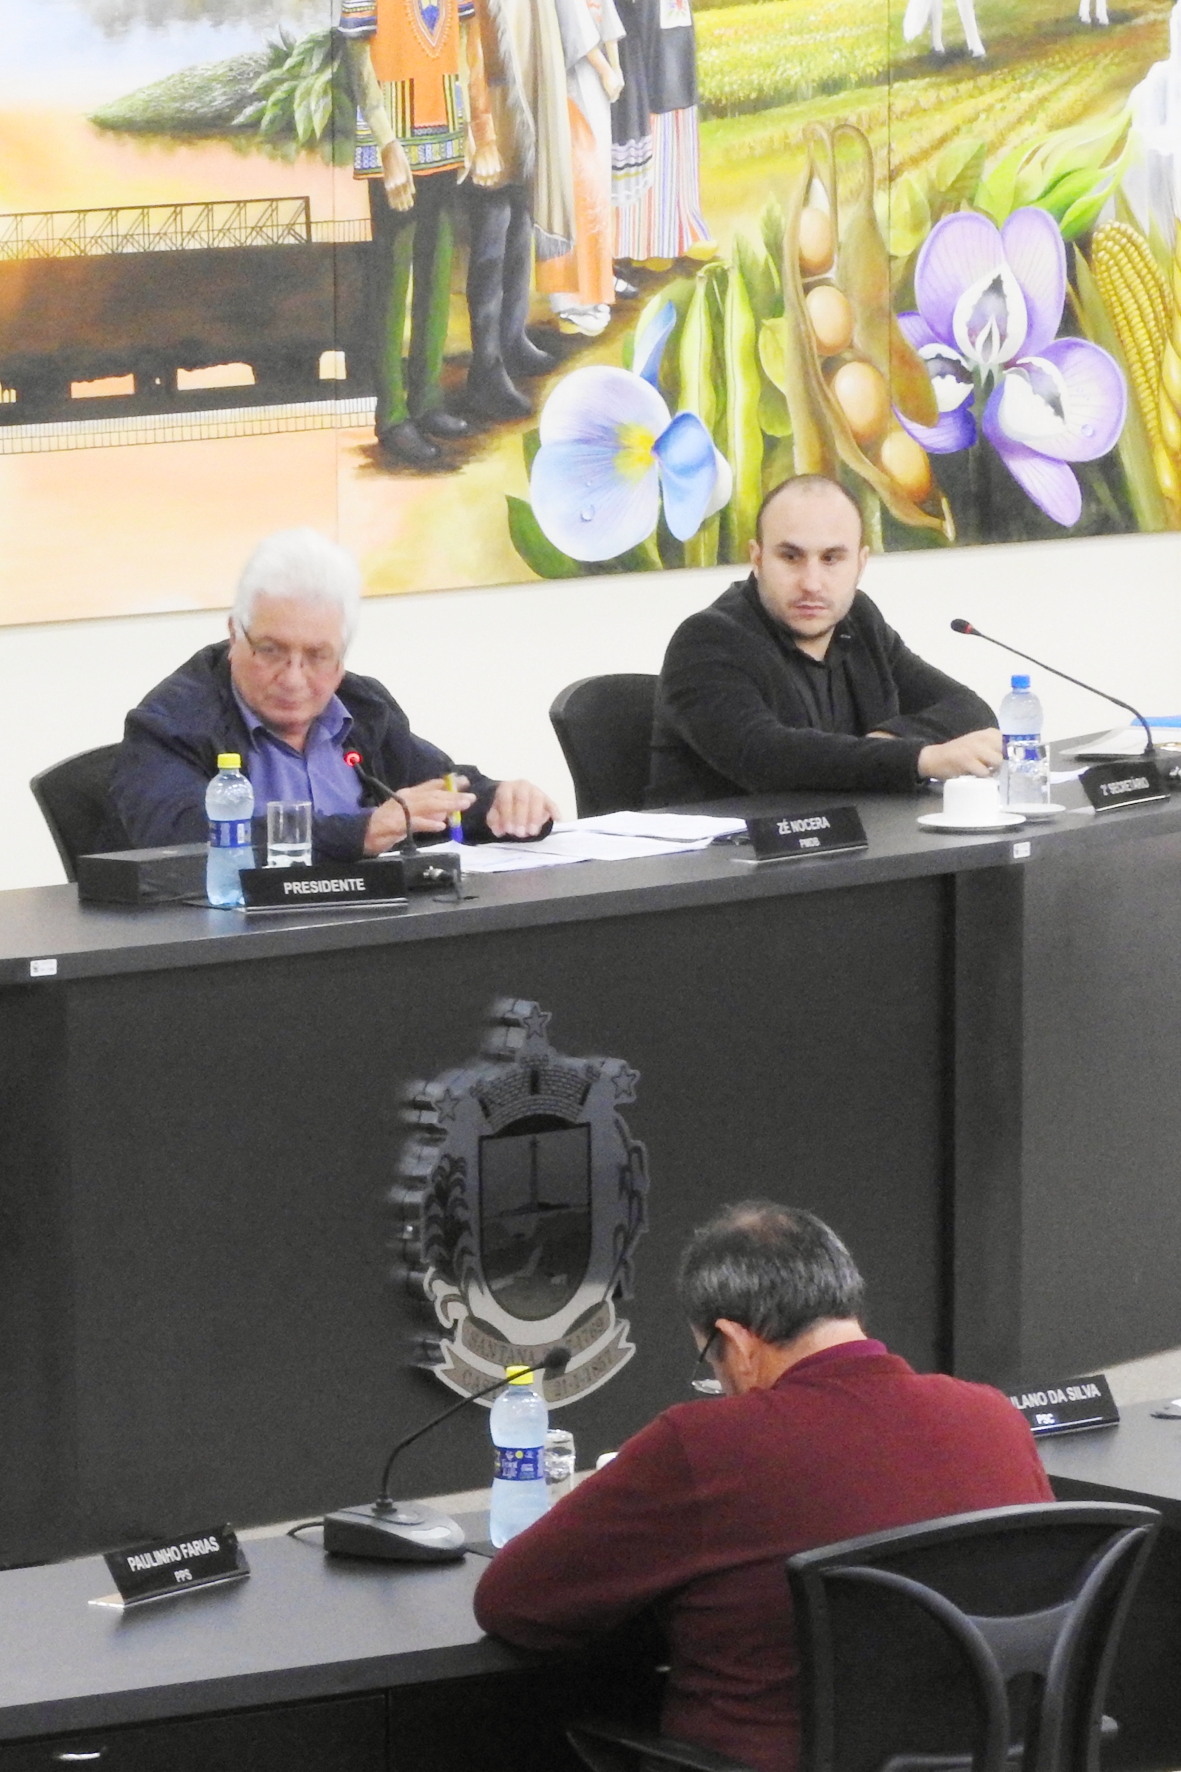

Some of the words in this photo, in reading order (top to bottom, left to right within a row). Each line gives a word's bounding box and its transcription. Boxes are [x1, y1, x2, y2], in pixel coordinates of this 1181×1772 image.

[776, 818, 791, 835] ZÉ
[790, 816, 831, 833] NOCERA
[283, 878, 366, 895] PRESIDENTE
[1046, 1388, 1068, 1405] DA
[1065, 1383, 1102, 1402] SILVA
[1035, 1413, 1056, 1425] PSC
[127, 1545, 182, 1572] PAULINHO
[179, 1536, 220, 1559] FARIAS
[174, 1568, 193, 1582] PPS
